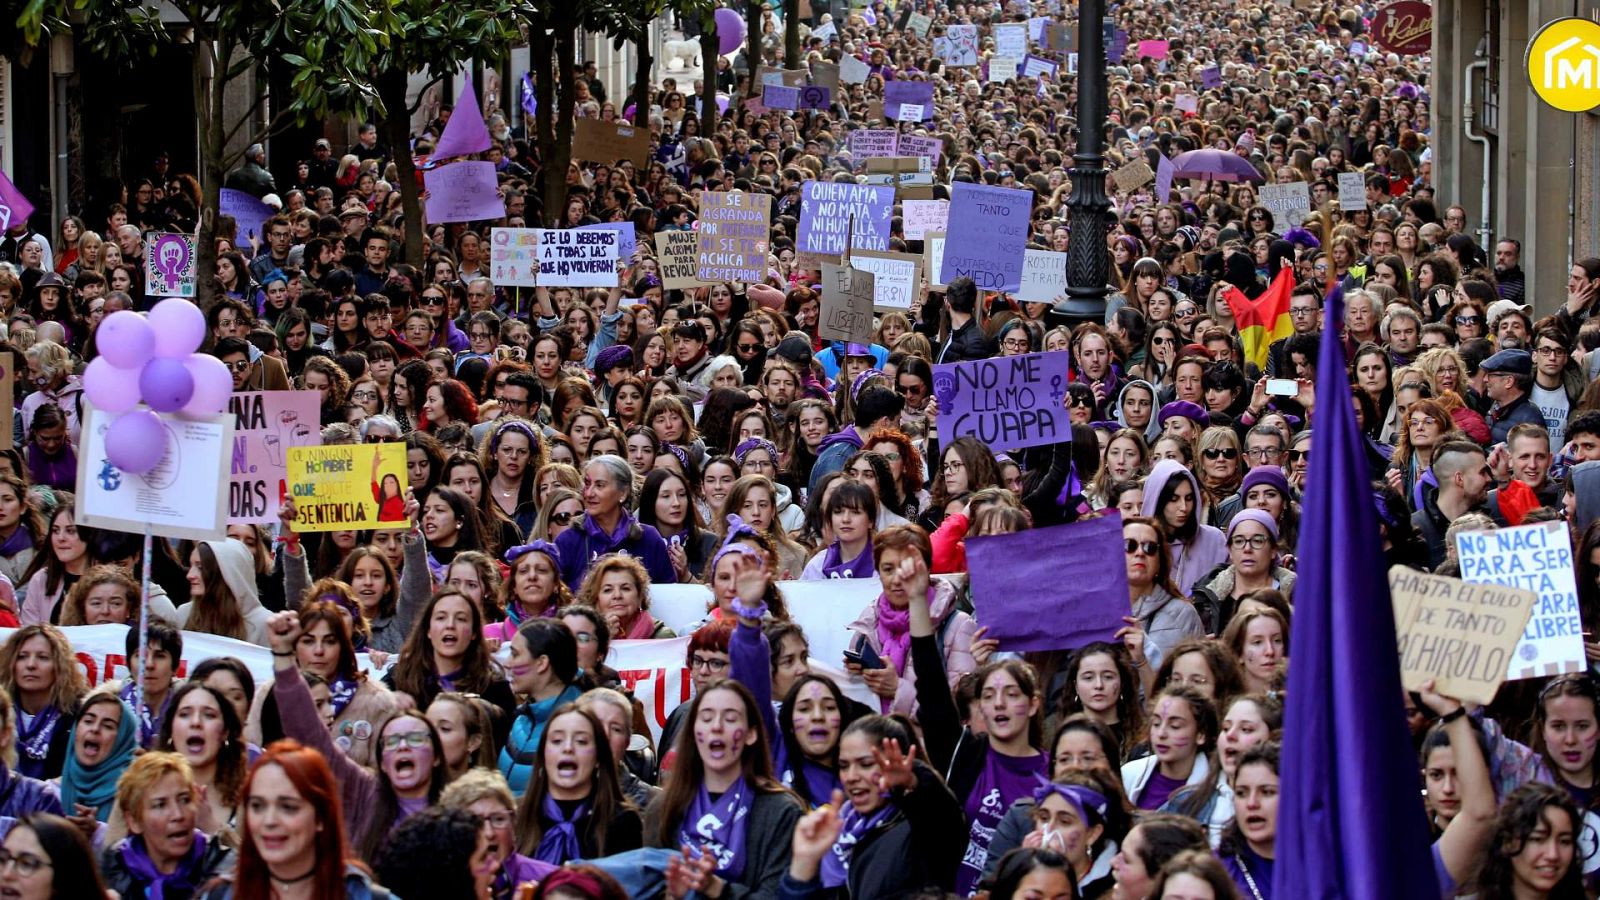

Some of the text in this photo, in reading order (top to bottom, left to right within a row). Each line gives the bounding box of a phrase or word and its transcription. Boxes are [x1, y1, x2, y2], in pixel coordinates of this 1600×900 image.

[1558, 59, 1591, 88] M
[726, 194, 742, 206] SE
[811, 183, 878, 205] QUIEN AMA
[703, 208, 764, 222] AGRANDA
[818, 202, 836, 217] NO
[976, 203, 1010, 217] TANTO
[700, 222, 718, 234] POR
[812, 217, 824, 232] NI
[998, 224, 1022, 238] QUE
[542, 232, 556, 245] SE
[559, 232, 571, 244] LO
[576, 232, 616, 245] DEBEMOS
[668, 232, 698, 244] MUJE
[719, 238, 736, 252] SE
[808, 233, 822, 251] NI
[545, 248, 552, 258] A
[556, 246, 586, 258] TODAS
[590, 246, 606, 257] LAS
[700, 252, 743, 266] ACHICA
[540, 259, 614, 276] QUE NO VOLVIERON
[674, 256, 694, 264] PARA
[698, 266, 762, 282] RESPETARME
[956, 268, 1006, 290] MIEDO
[1031, 272, 1066, 286] TRATA
[160, 284, 168, 293] EL
[954, 355, 1042, 390] NO ME
[972, 386, 1036, 412] LLAMO
[953, 408, 1056, 445] GUAPA
[306, 459, 353, 474] HOMBRE
[294, 482, 316, 496] QUE
[300, 502, 367, 524] SENTENCIA
[1459, 527, 1546, 556] NO NACI
[1463, 548, 1570, 577] PARA SER
[1392, 574, 1521, 608] HASTA EL CULO
[1417, 608, 1506, 636] DE TANTO
[1524, 616, 1580, 640] LIBRE
